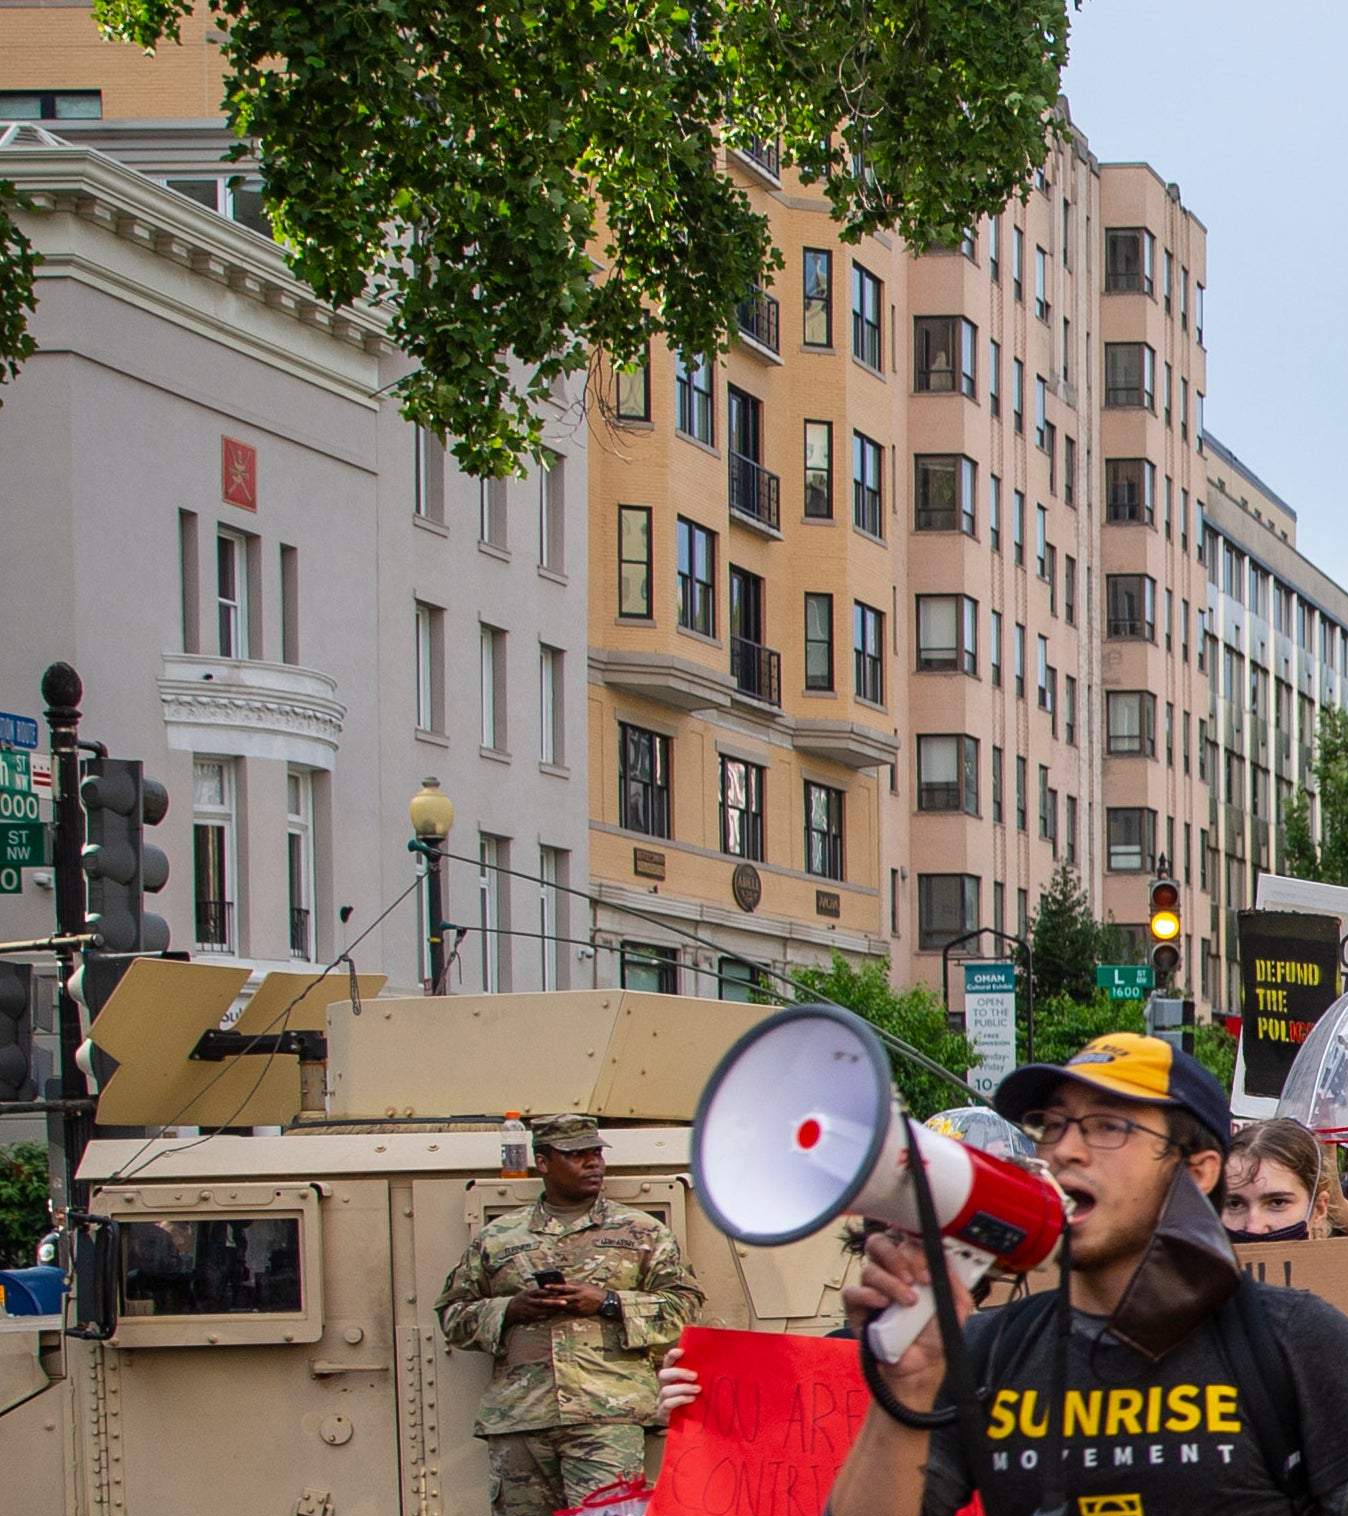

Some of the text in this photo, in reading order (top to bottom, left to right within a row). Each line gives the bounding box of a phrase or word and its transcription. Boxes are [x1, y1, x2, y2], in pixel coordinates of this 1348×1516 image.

[16, 755, 27, 773] ST
[8, 830, 29, 844] ST
[7, 847, 31, 860] NW
[974, 974, 1006, 983] OMAN
[1114, 969, 1147, 984] L ST
[1256, 959, 1320, 986] DEFUND
[1112, 986, 1140, 998] 1600
[977, 998, 1005, 1007] OPEN
[1256, 989, 1288, 1013] THE
[972, 1007, 1010, 1017] TO THE
[974, 1018, 1008, 1028] PUBLIC
[987, 1384, 1242, 1440] SUNRISE
[993, 1444, 1235, 1471] MOEMENT
